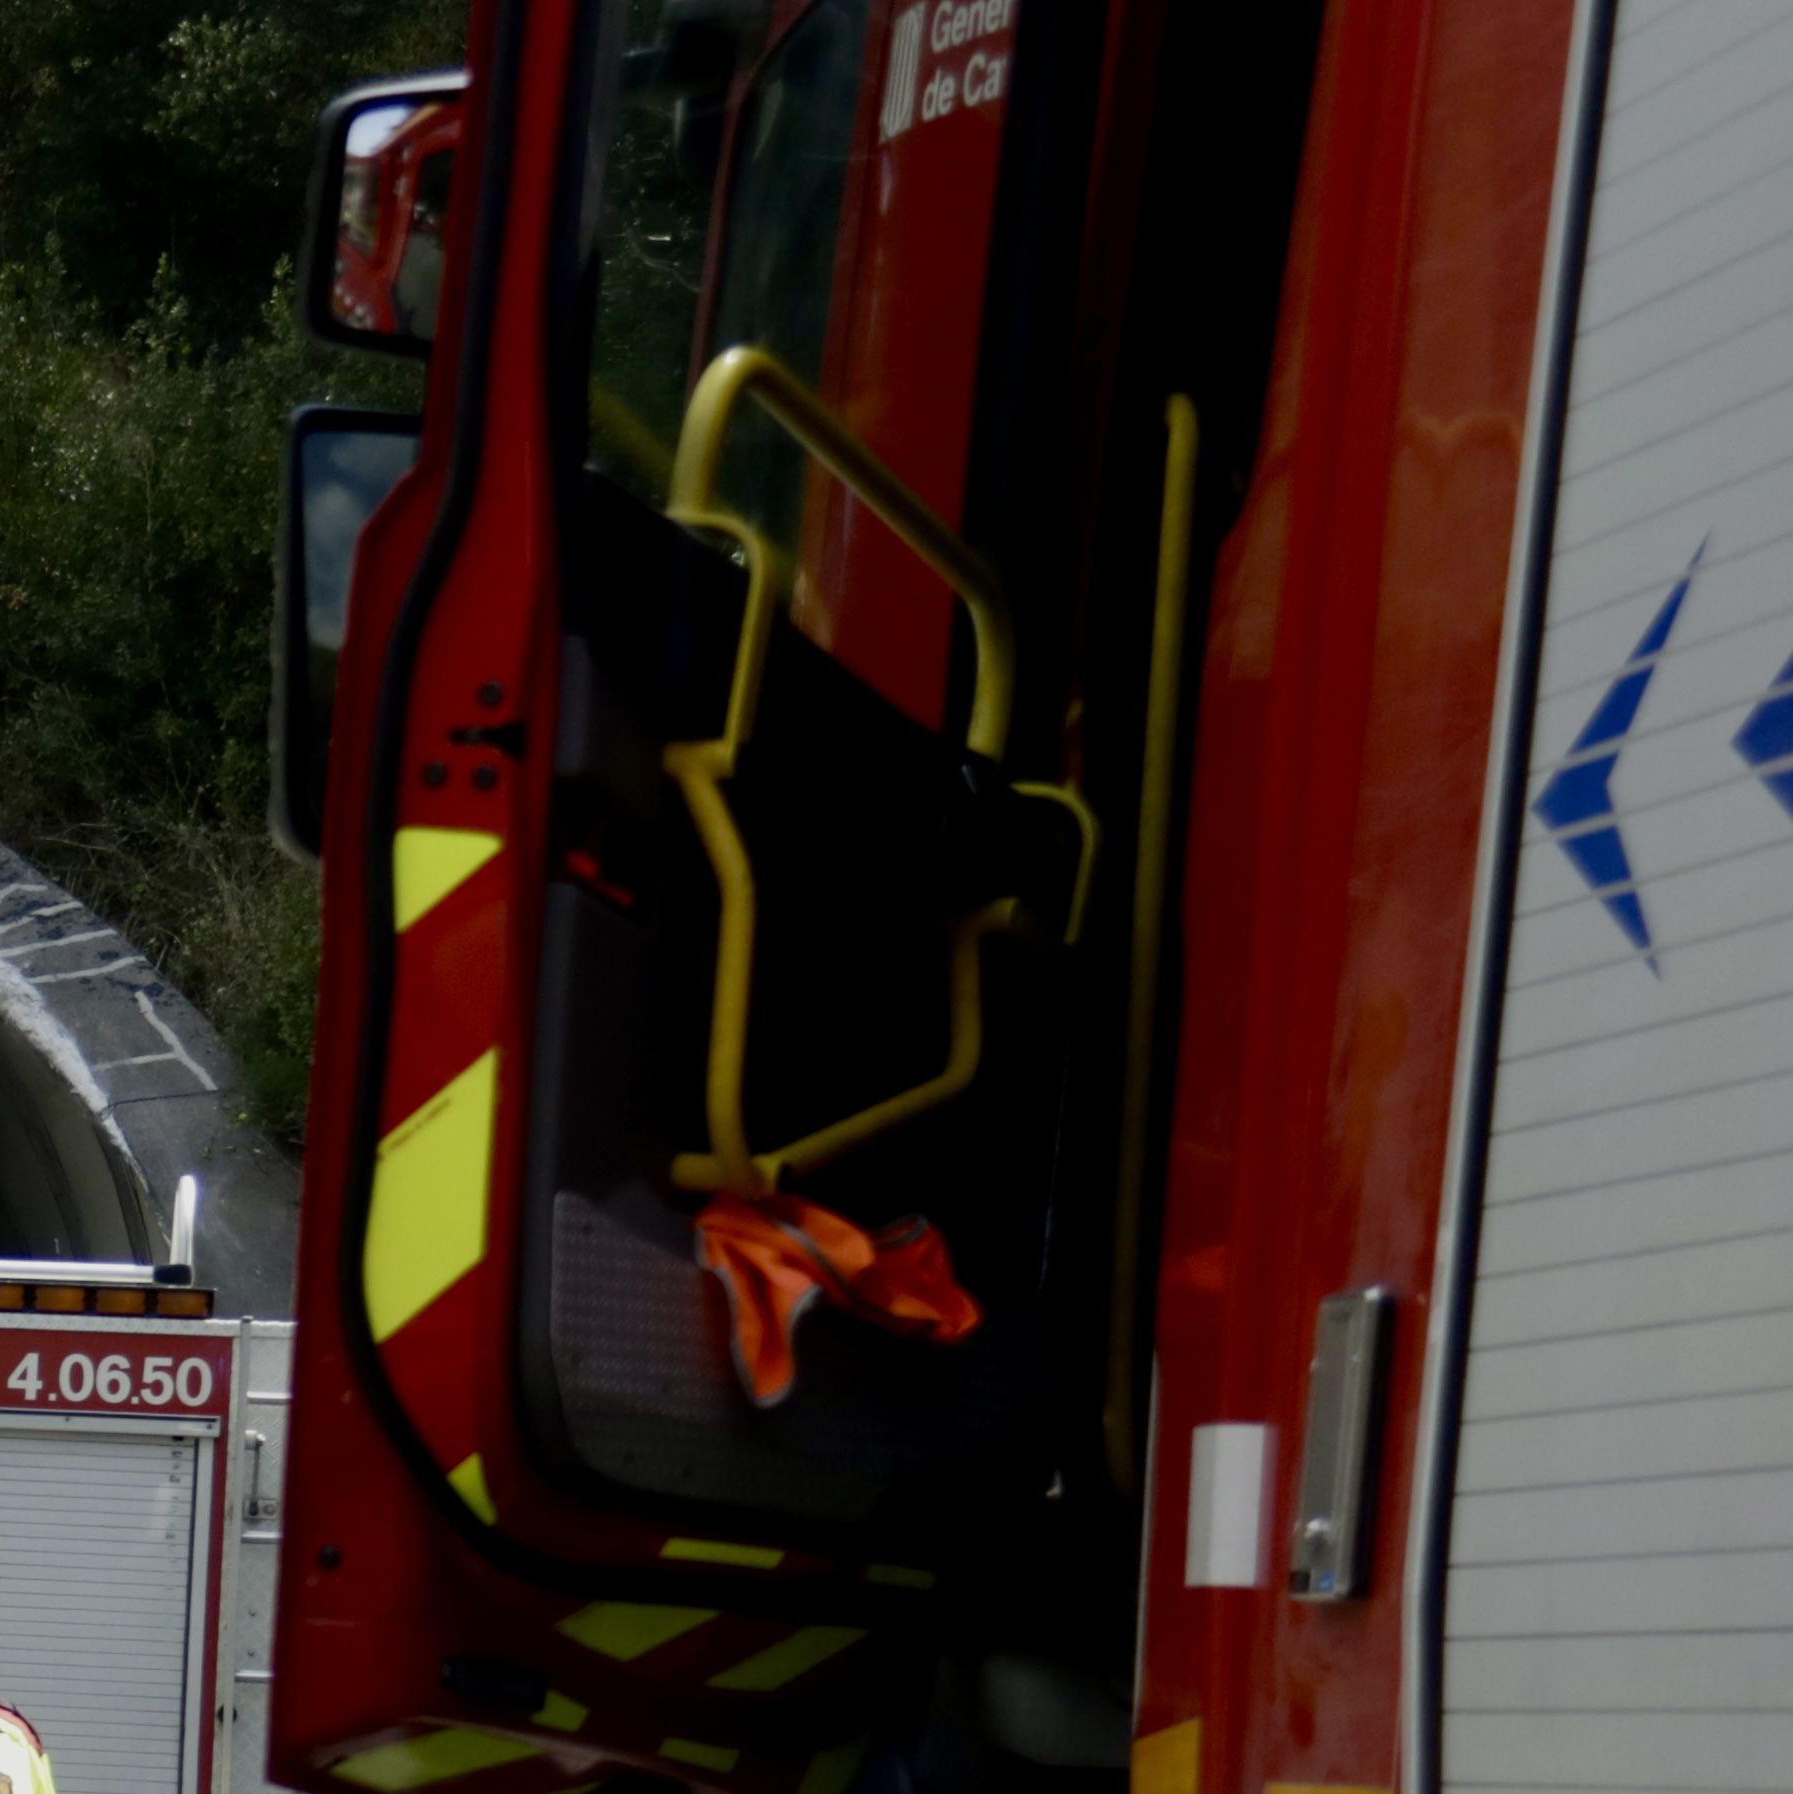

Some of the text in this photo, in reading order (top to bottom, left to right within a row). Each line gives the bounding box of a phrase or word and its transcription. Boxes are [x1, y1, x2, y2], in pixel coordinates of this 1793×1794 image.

[921, 52, 1007, 122] de Ca
[7, 1352, 212, 1407] 4.06.50
